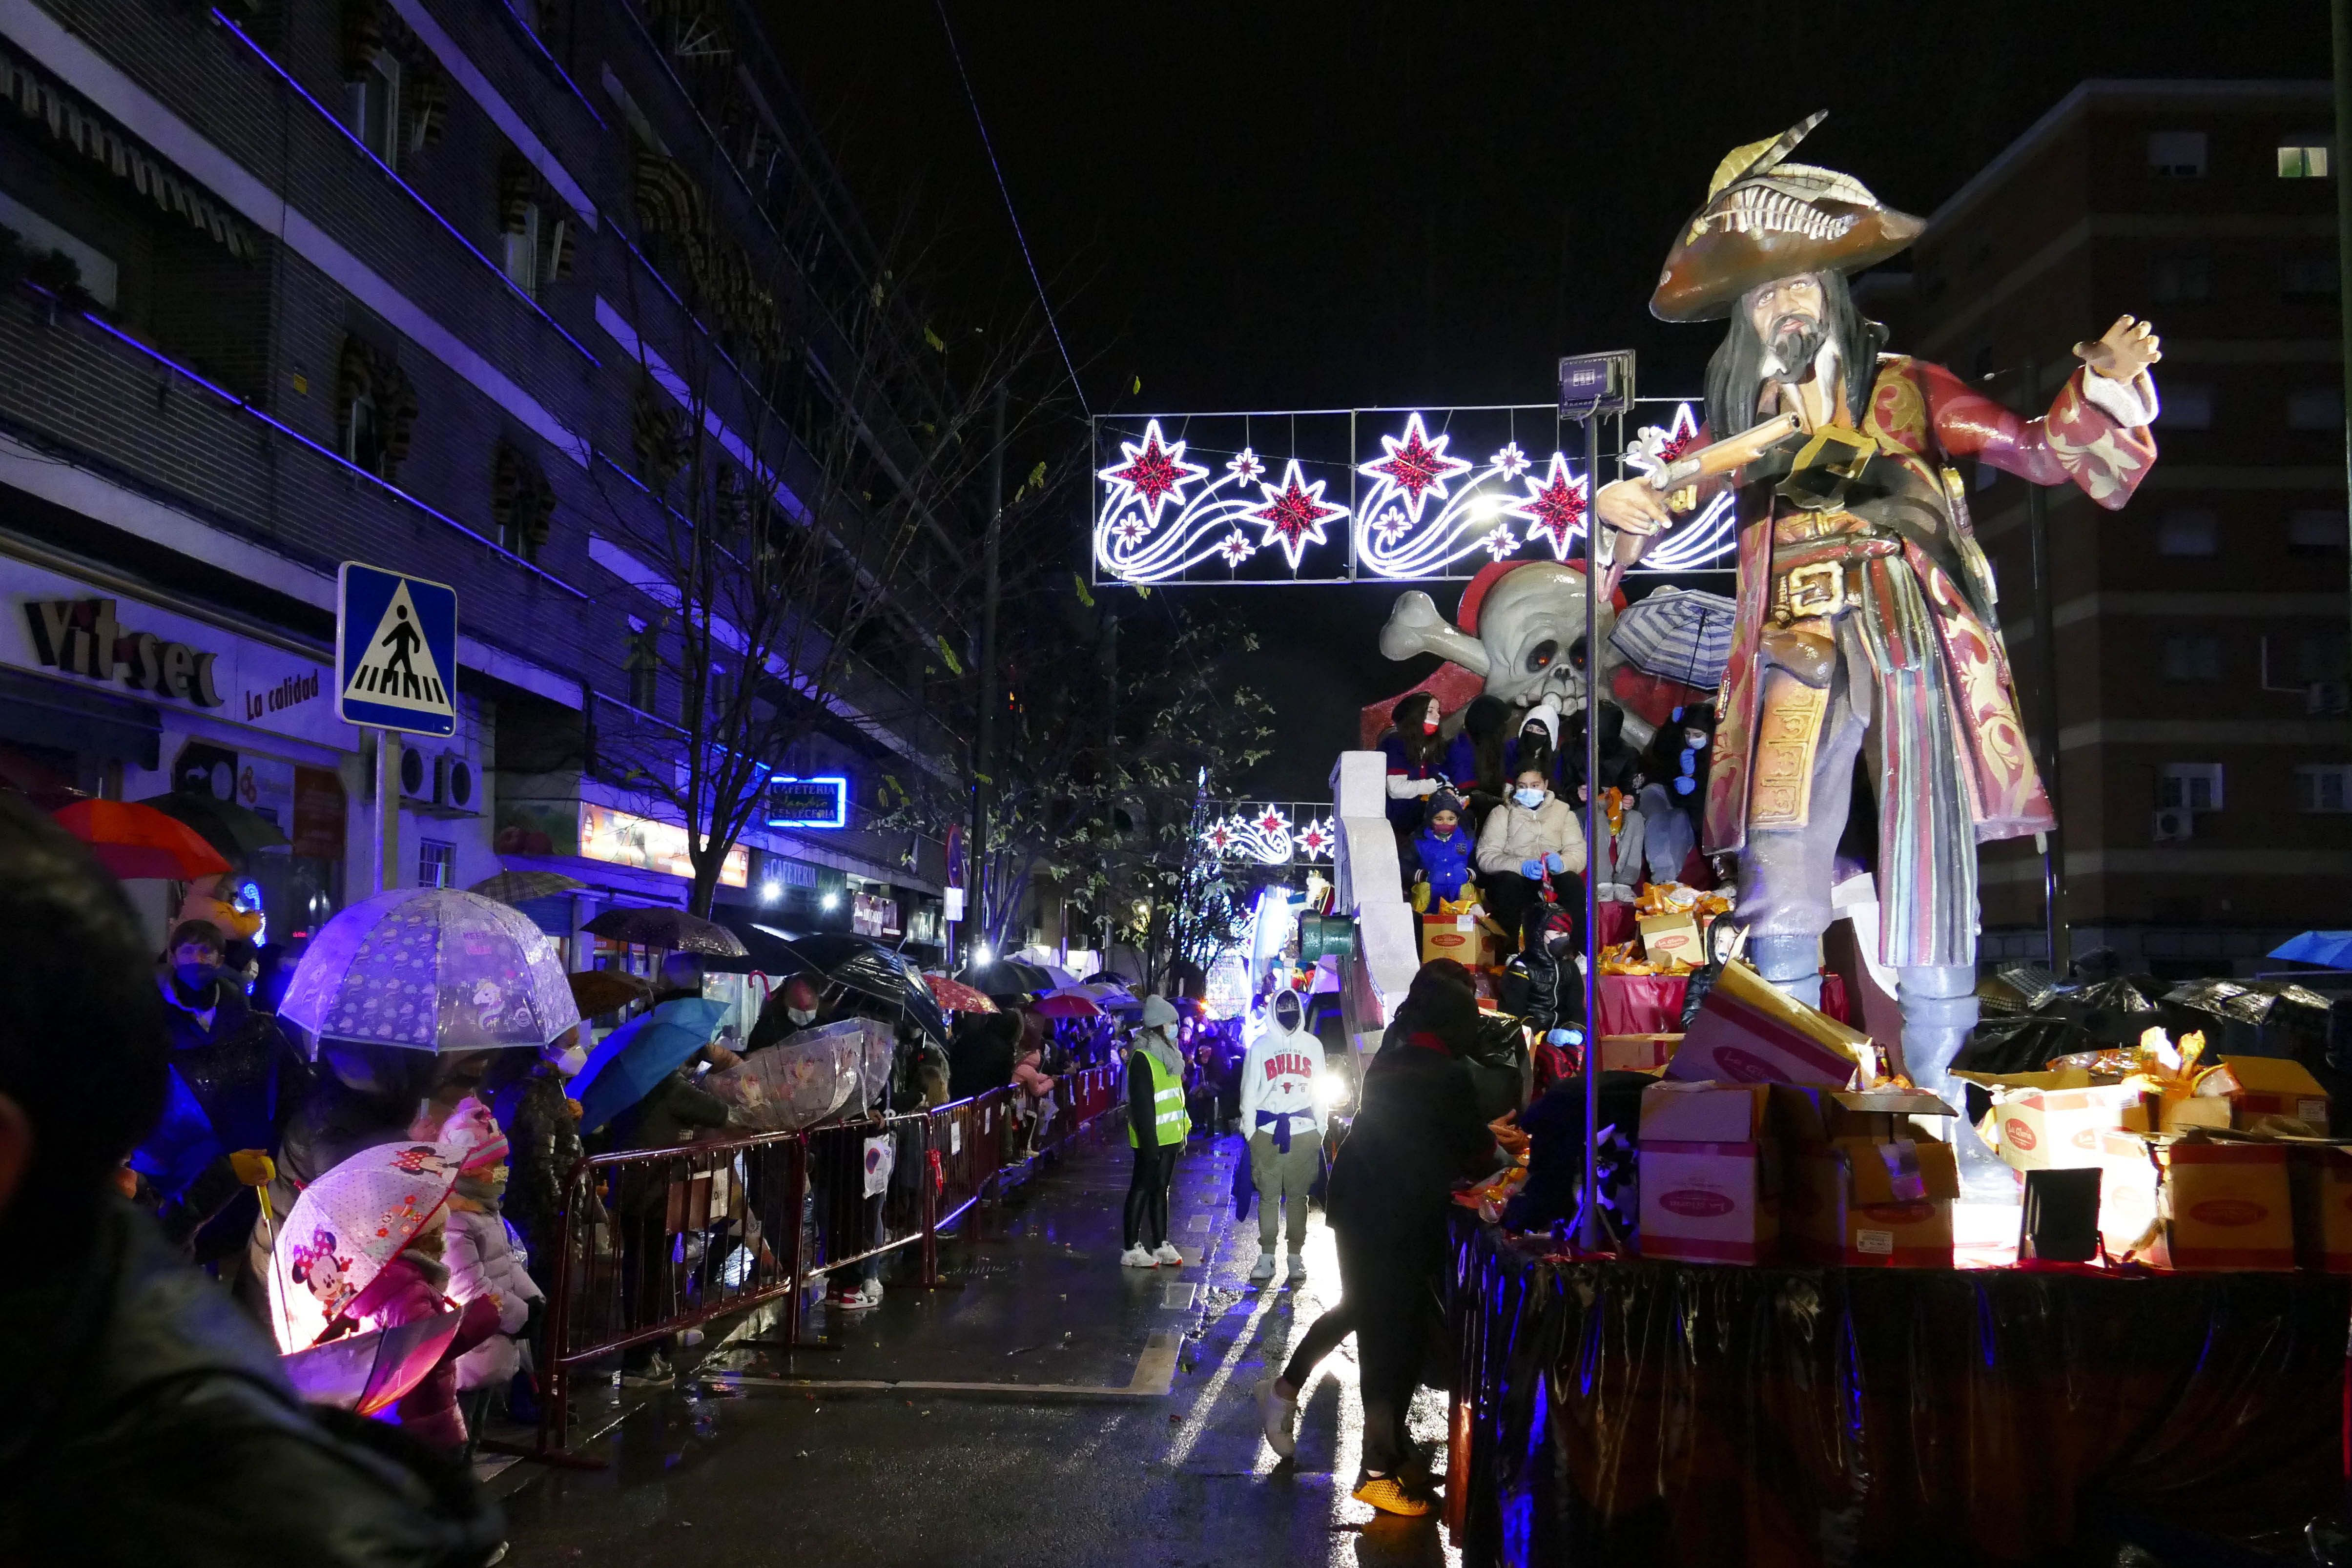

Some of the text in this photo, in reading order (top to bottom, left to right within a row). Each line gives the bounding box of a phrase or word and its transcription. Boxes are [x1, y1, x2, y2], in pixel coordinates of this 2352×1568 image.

[246, 669, 318, 721] La calidad
[774, 784, 835, 795] CAFETERIA
[771, 859, 817, 888] CAFETERIA
[1264, 1053, 1312, 1082] BULLS
